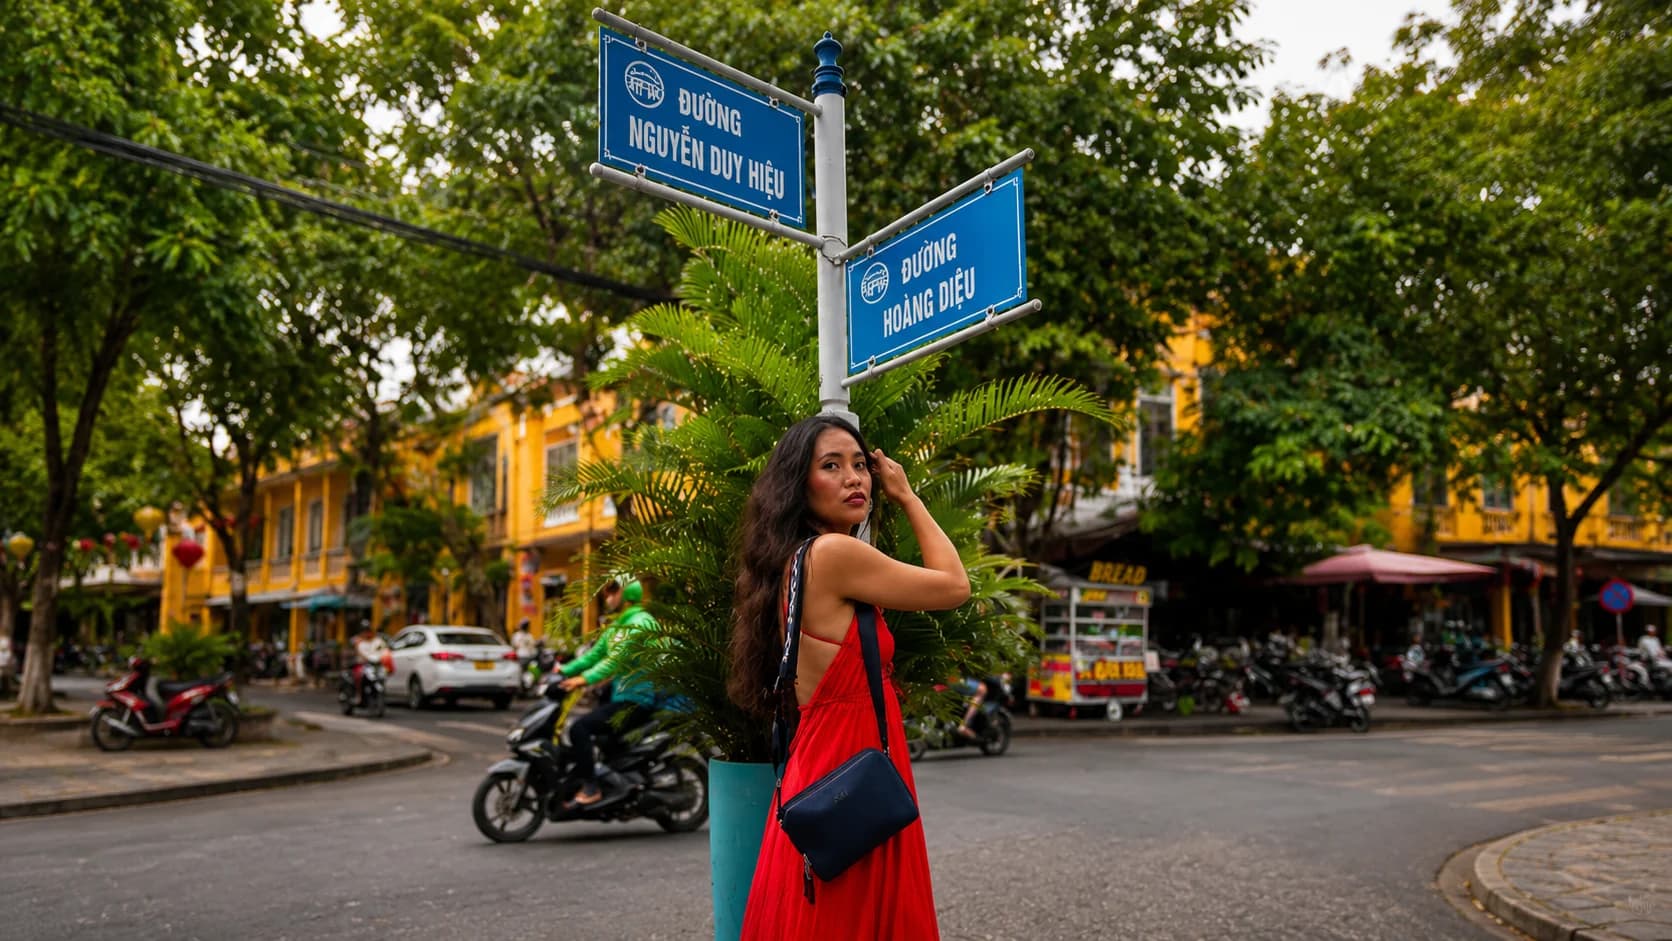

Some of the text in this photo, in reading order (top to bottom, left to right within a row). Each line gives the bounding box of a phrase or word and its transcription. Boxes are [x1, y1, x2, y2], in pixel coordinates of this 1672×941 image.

[678, 88, 742, 137] ĐƯỜNG
[629, 115, 785, 200] NGUYỄN DUY HIỆU
[901, 233, 957, 284] ĐƯỜNG
[883, 267, 975, 338] HOÀNG DIỆU
[1090, 561, 1147, 585] BREAD
